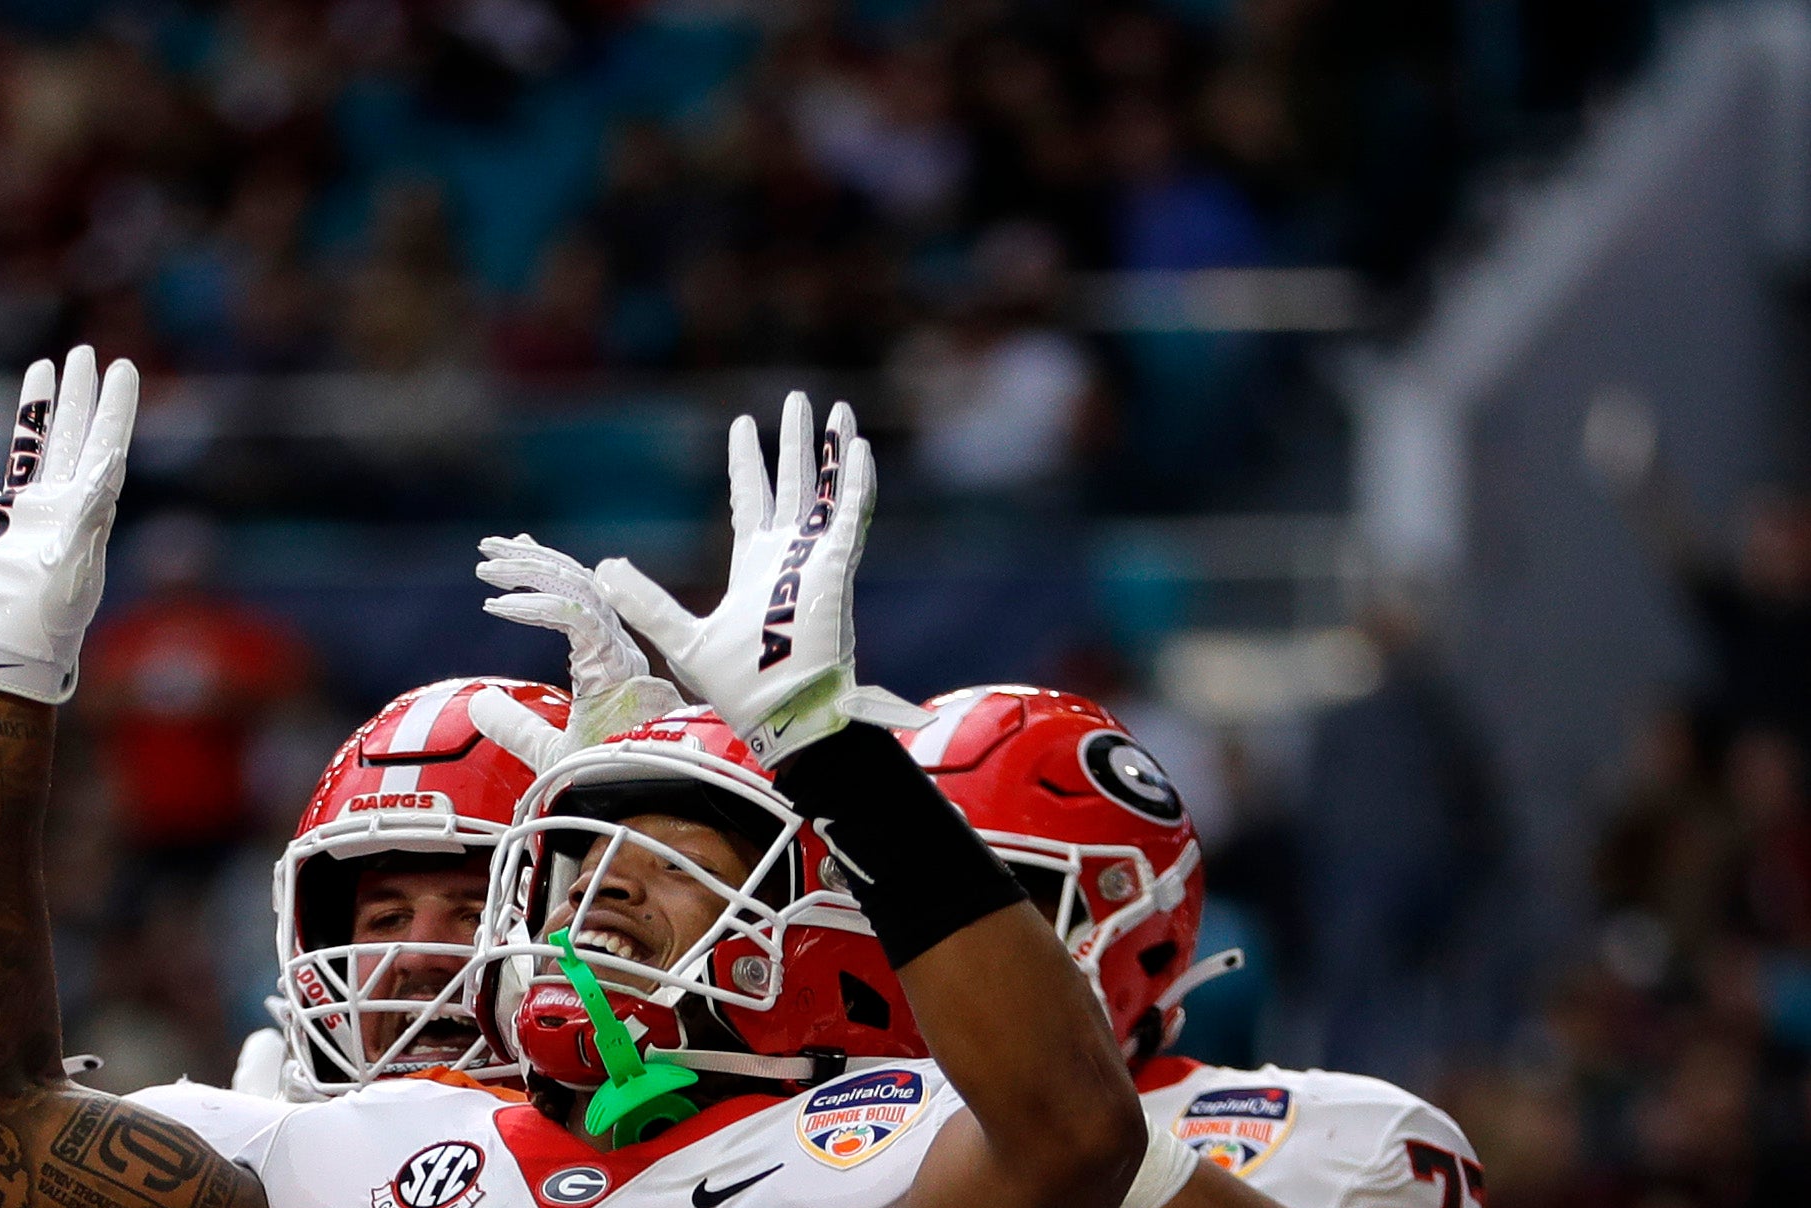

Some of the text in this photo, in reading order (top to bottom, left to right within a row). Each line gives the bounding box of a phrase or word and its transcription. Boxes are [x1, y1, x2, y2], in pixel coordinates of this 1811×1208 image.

[349, 794, 435, 812] DAWGS
[296, 968, 343, 1030] DOS
[804, 1106, 908, 1133] ORANGE BOWL
[1179, 1120, 1273, 1144] ORANGE BOWL
[399, 1144, 478, 1208] SEC
[542, 1167, 608, 1205] G
